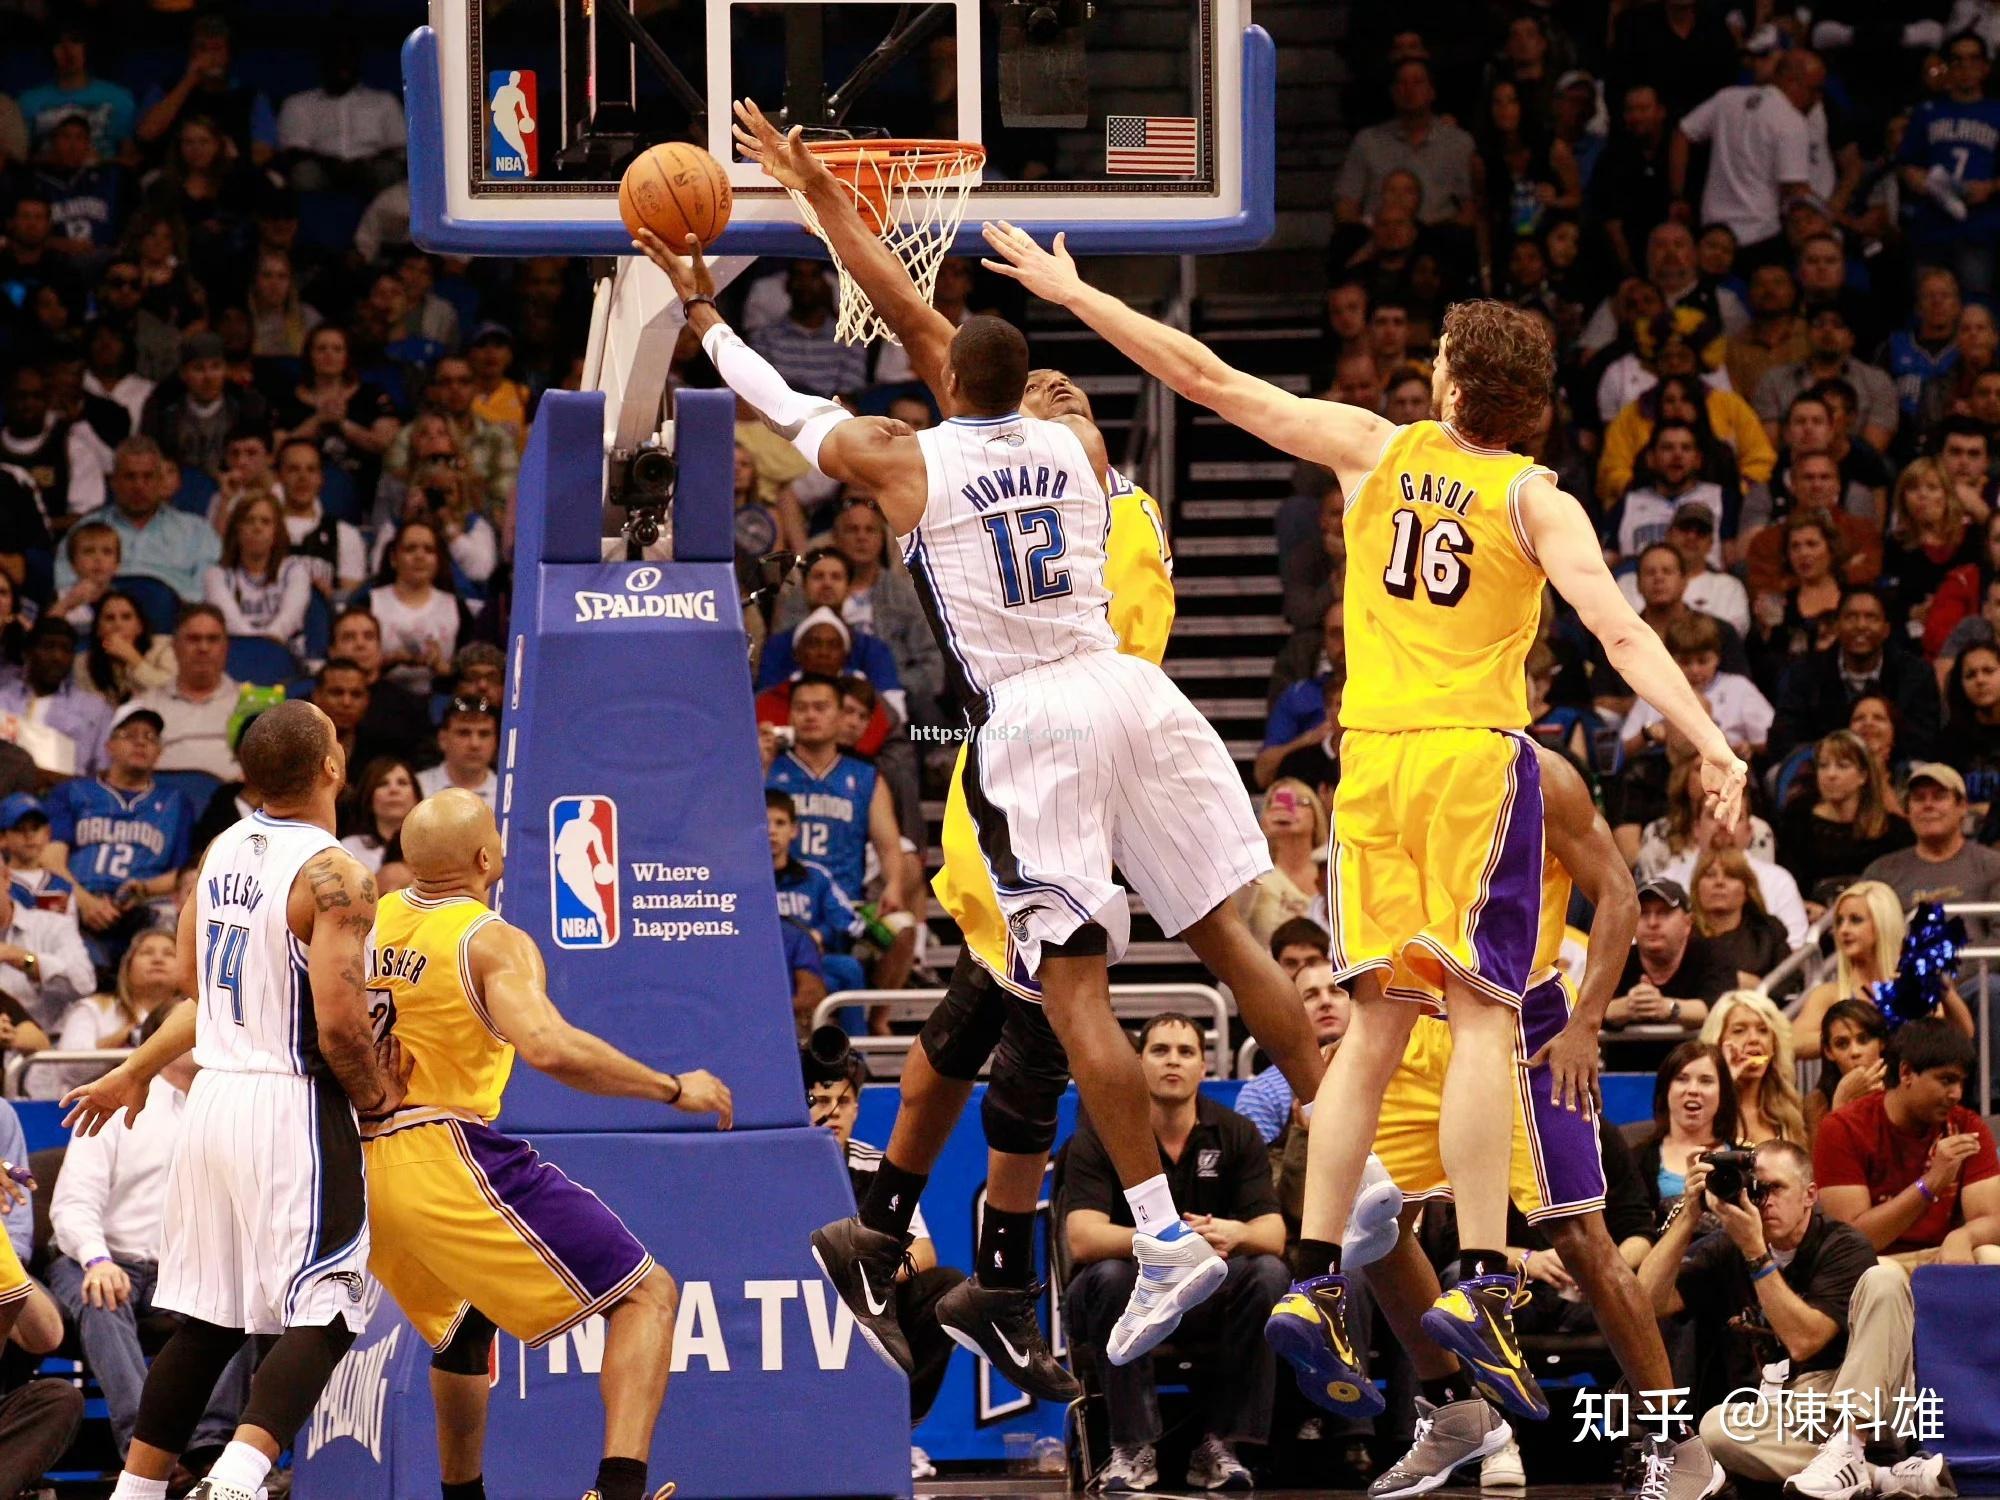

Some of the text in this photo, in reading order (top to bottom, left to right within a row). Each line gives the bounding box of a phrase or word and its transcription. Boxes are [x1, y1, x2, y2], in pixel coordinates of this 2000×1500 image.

[496, 156, 522, 172] NBA
[961, 465, 1068, 512] HOWARD
[1400, 472, 1475, 517] GASOL
[982, 505, 1073, 609] 12
[1382, 507, 1475, 608] 16
[574, 589, 717, 623] SPALDING
[76, 816, 165, 857] ORLANDO
[801, 821, 828, 856] 12
[95, 843, 134, 878] 12
[631, 863, 710, 882] Where
[632, 889, 737, 913] amazing
[776, 891, 812, 921] GIC
[561, 917, 599, 938] NBA
[632, 918, 740, 942] happens.
[204, 919, 250, 1028] 14
[368, 947, 428, 985] ISHER
[744, 1279, 856, 1371] TV
